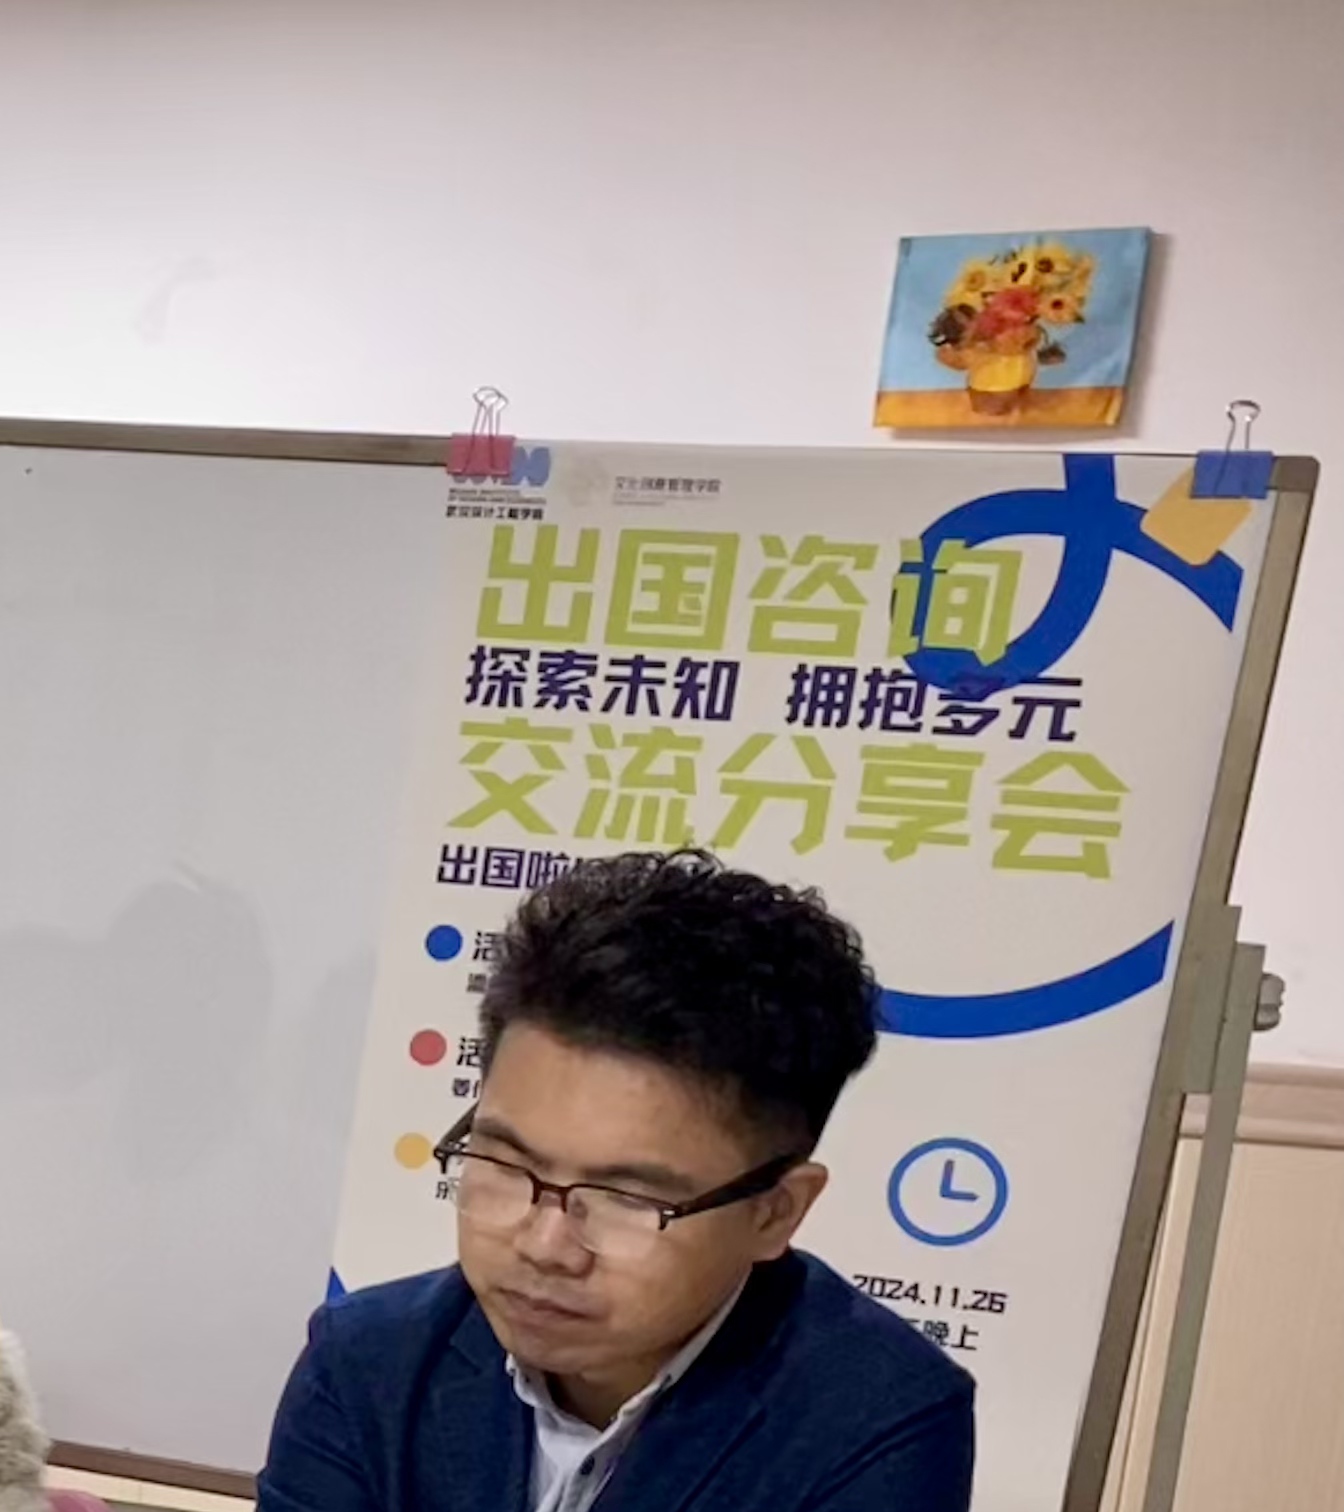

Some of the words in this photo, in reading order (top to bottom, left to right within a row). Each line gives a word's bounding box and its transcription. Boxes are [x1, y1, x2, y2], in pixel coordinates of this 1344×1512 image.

[475, 523, 1023, 667] 出国咨询
[464, 645, 740, 722] 探索未知
[786, 662, 1083, 742] 拥抱多元
[446, 715, 1132, 879] 交流分享会
[852, 1274, 1008, 1314] 2024.11.26
